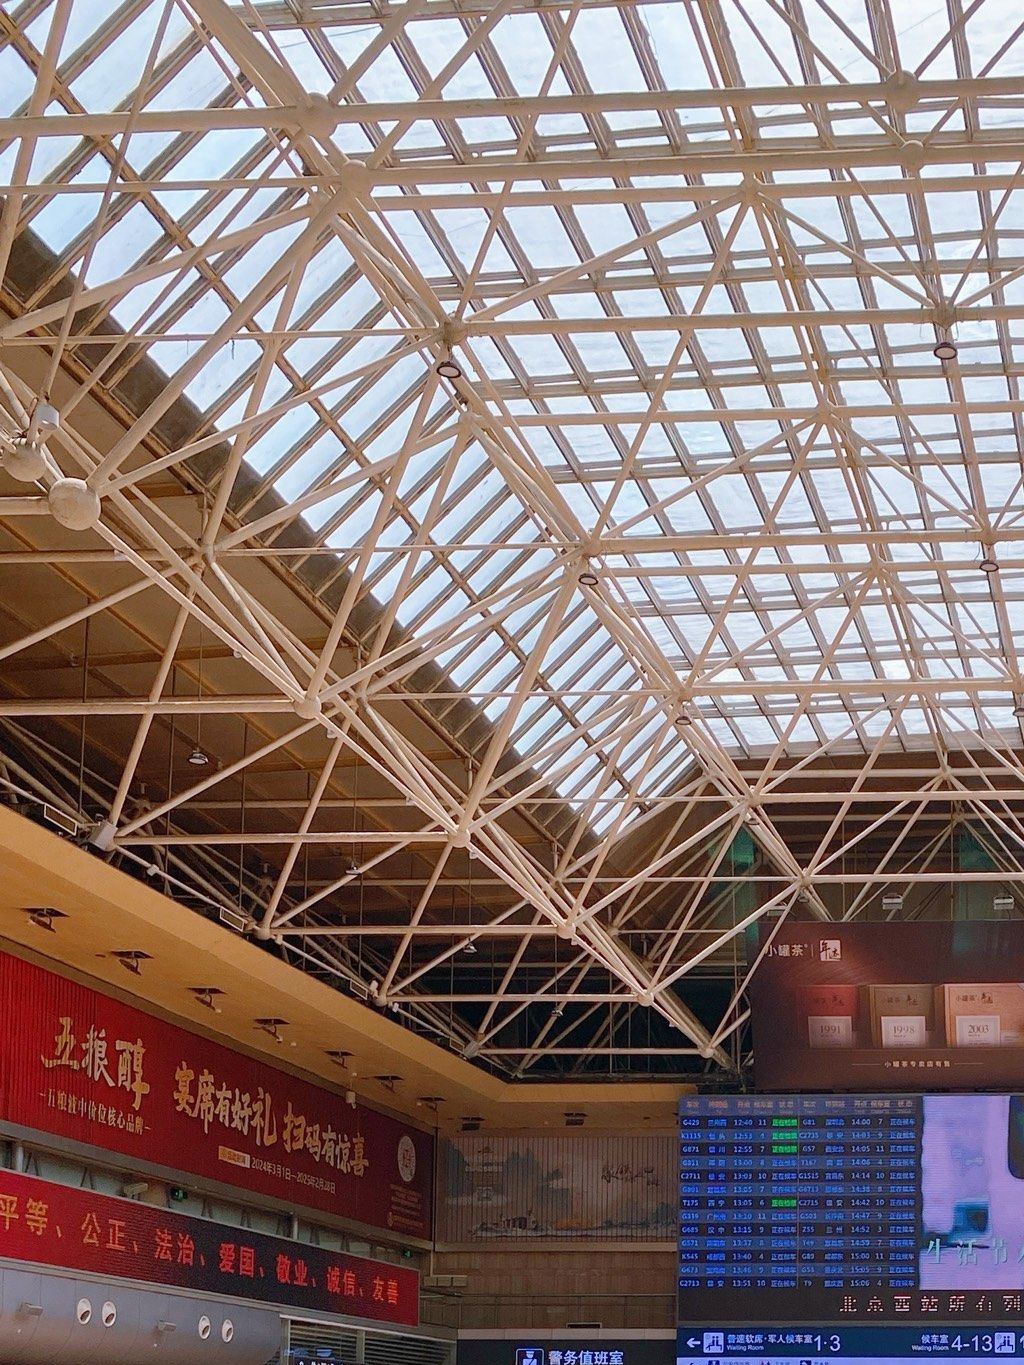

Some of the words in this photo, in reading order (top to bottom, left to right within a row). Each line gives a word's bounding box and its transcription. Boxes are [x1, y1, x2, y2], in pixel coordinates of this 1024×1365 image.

[819, 1024, 841, 1034] 1991
[893, 1025, 915, 1034] 1998
[968, 1024, 989, 1034] 2003
[174, 1061, 277, 1147] 宴席有好礼
[283, 1101, 370, 1177] 扫码有惊喜
[727, 1334, 813, 1344] 普速软席·军人候车室
[921, 1334, 949, 1344] 候车室
[951, 1335, 993, 1352] 4-13
[548, 1351, 624, 1365] 警务值班室
